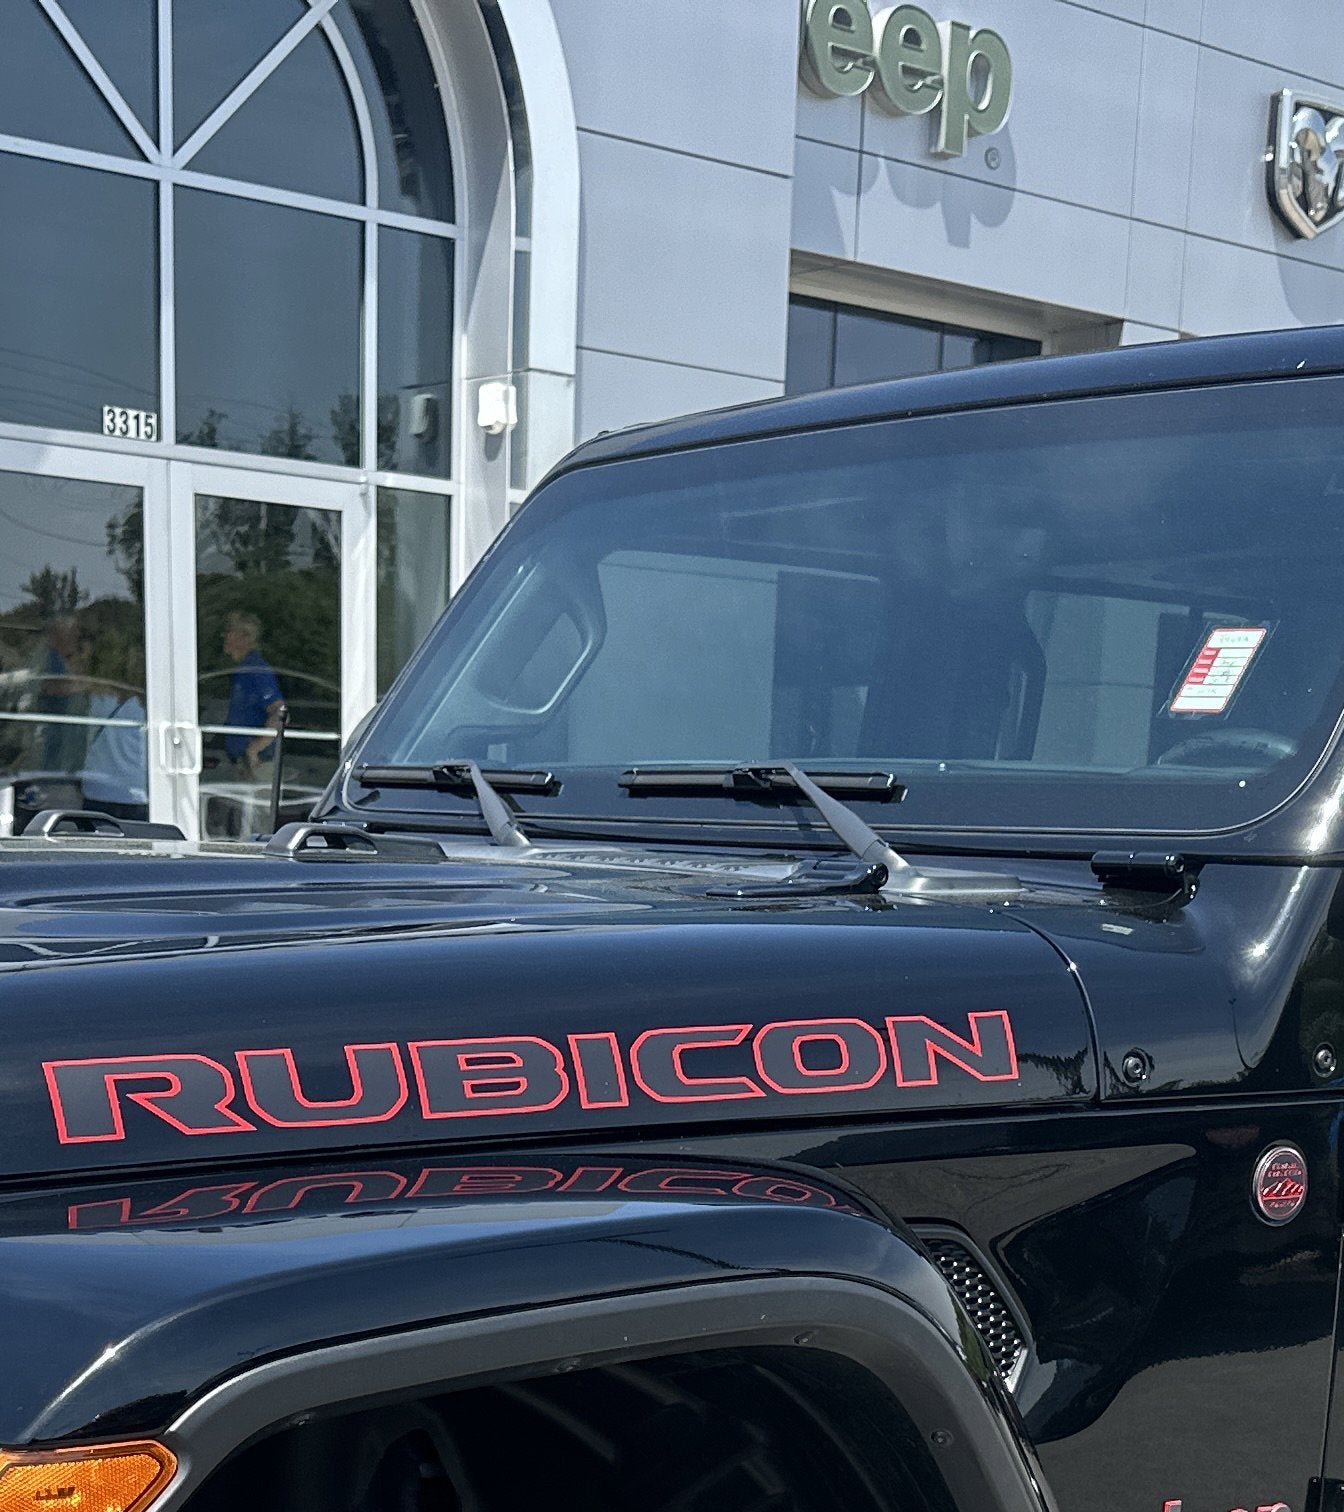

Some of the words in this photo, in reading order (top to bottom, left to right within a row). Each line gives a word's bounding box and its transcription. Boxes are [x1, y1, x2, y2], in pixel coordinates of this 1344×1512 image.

[800, 0, 1012, 158] eep
[106, 408, 154, 440] 3315
[42, 1009, 1019, 1145] RUBICON
